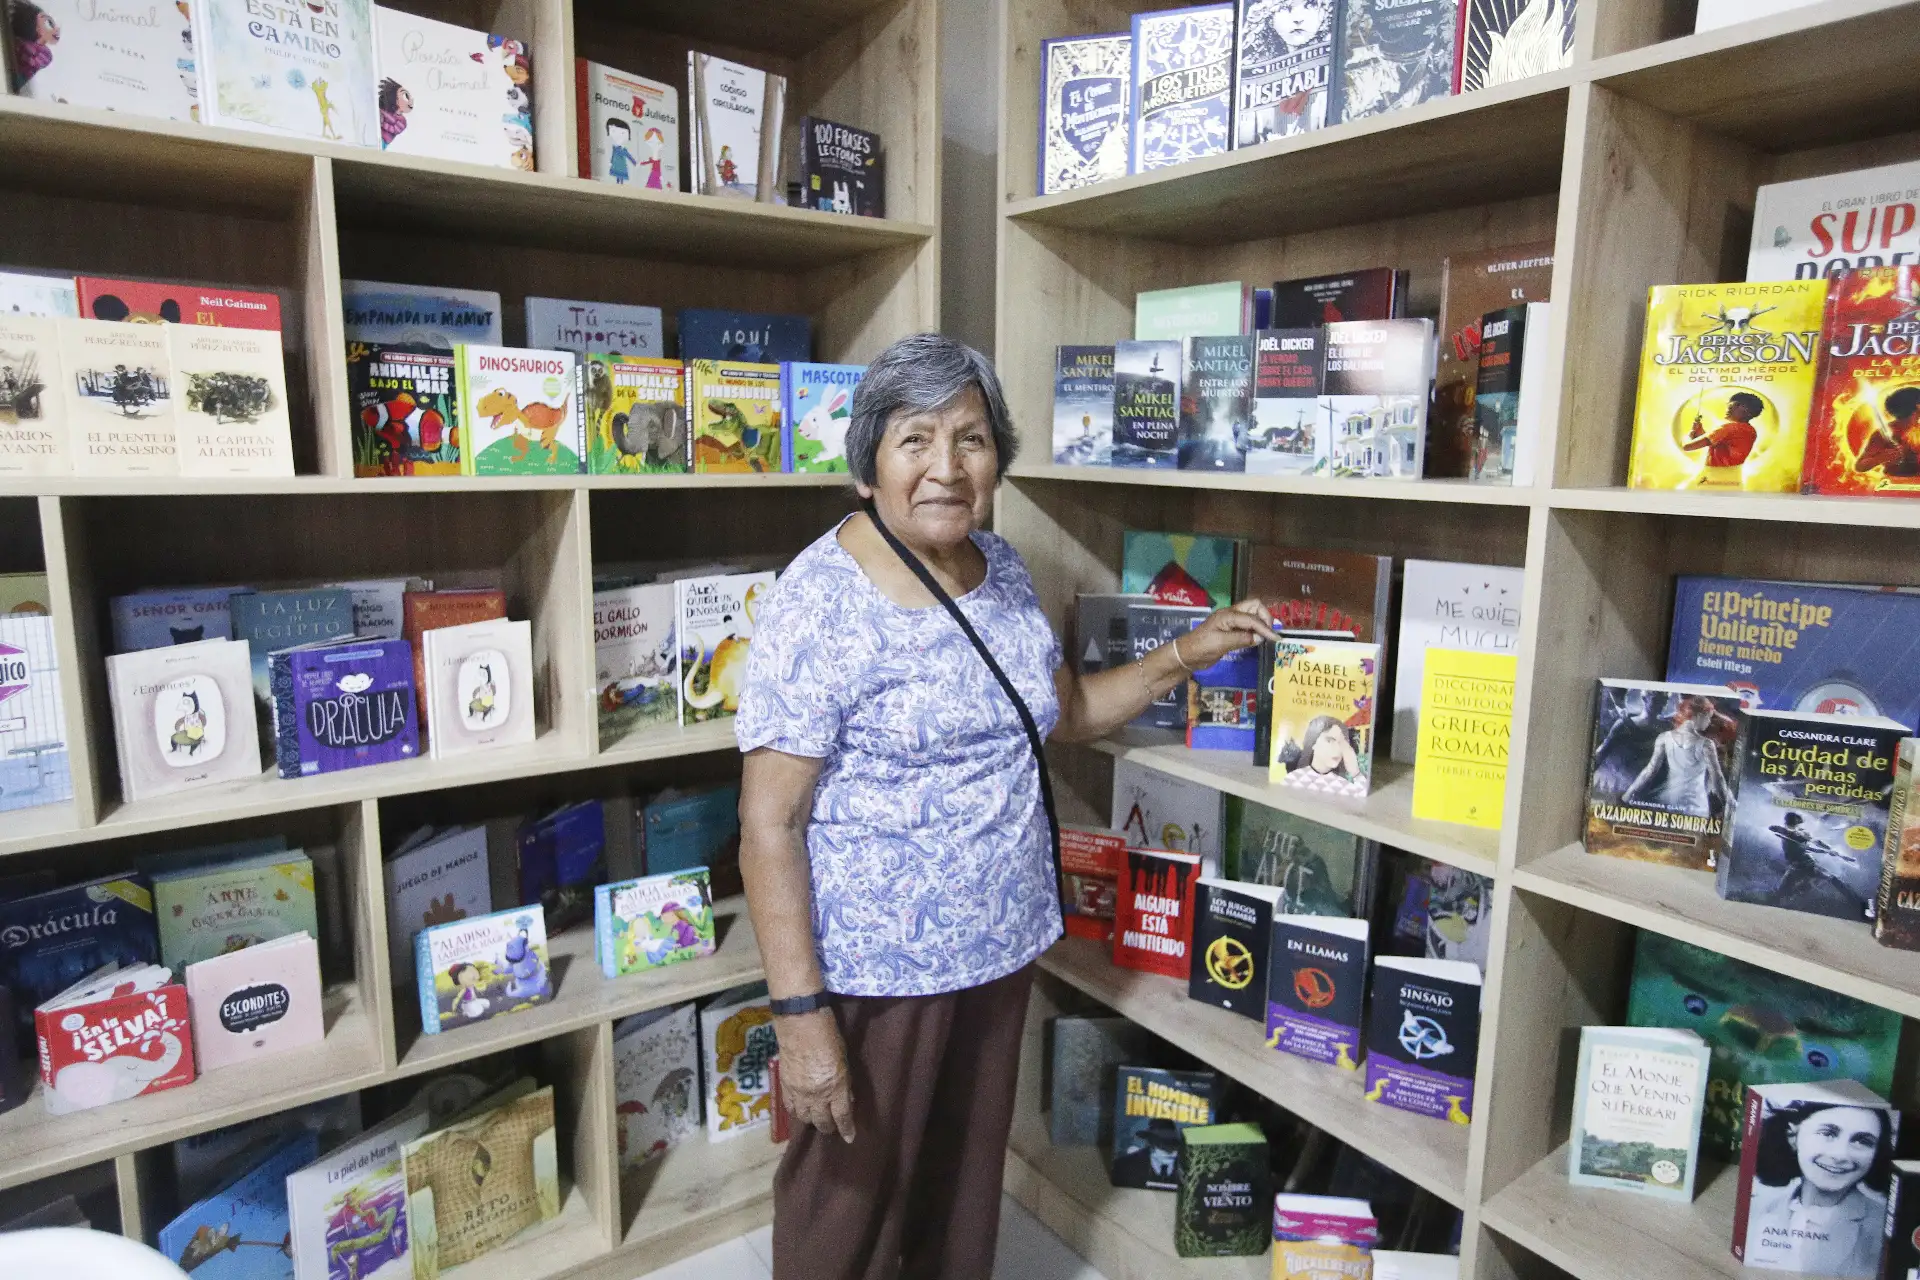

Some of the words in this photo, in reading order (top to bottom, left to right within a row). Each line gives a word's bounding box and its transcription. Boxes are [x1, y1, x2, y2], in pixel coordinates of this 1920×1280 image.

[311, 17, 339, 38] EN
[248, 21, 341, 59] CAMINO
[1151, 72, 1183, 97] LOS
[1185, 61, 1227, 87] TRES
[720, 83, 747, 98] CÓDIGO
[1143, 76, 1229, 112] MOSQUETEROS
[595, 92, 631, 112] Romeo
[645, 107, 676, 125] Julieta
[815, 123, 833, 144] 100
[834, 127, 871, 154] FRASES
[1822, 201, 1832, 211] EL
[1836, 196, 1865, 210] GRAN
[1870, 190, 1902, 205] LIBRO
[1905, 188, 1919, 199] DE
[1488, 262, 1517, 273] OLIVER
[1511, 288, 1524, 299] EL
[1678, 289, 1717, 298] RICK
[1726, 284, 1810, 296] RIORDAN
[200, 296, 223, 307] Neil
[225, 299, 267, 311] Gaiman
[197, 311, 215, 325] El
[345, 308, 420, 325] EMPANADA
[441, 310, 493, 326] MAMUT
[569, 306, 598, 327] Tú
[722, 324, 771, 346] AQUÍ
[1259, 337, 1279, 351] JOËL
[1281, 338, 1315, 351] DICKER
[1328, 330, 1350, 345] JOËL
[1700, 334, 1772, 347] PERCY
[1204, 346, 1246, 357] MIKEL
[1328, 348, 1337, 358] EL
[1654, 331, 1821, 366] JACKSON
[479, 356, 564, 375] DINOSAURIOS
[1076, 355, 1113, 366] MIKEL
[1328, 360, 1342, 371] LOS
[1871, 358, 1893, 368] LA
[370, 362, 449, 380] ANIMALES
[1063, 367, 1114, 378] SANTIAG
[1669, 367, 1684, 375] EL
[1690, 366, 1742, 375] ÚLTIMO
[1747, 365, 1799, 374] HÉROE
[1720, 374, 1775, 383] OLIMPO
[1853, 369, 1885, 378] DEL
[370, 378, 399, 388] BAJO
[402, 380, 414, 390] EL
[416, 380, 449, 394] MAR
[614, 374, 679, 389] ANIMALES
[1064, 384, 1073, 392] EL
[1077, 384, 1115, 392] MENTIRO
[1200, 379, 1228, 388] ENTRE
[1231, 379, 1249, 388] LOS
[628, 390, 636, 398] LA
[638, 388, 675, 401] SELVA
[1135, 394, 1172, 405] MIKEL
[1201, 389, 1245, 398] MUERTOS
[1120, 407, 1175, 418] SANTIAG
[1133, 421, 1144, 430] EN
[1147, 422, 1174, 430] PLENA
[88, 433, 102, 442] EL
[109, 433, 161, 443] PUENTE
[197, 436, 210, 444] EL
[217, 435, 275, 445] CAPITÁN
[1137, 432, 1169, 440] NOCHE
[90, 445, 116, 455] LOS
[120, 445, 176, 455] ASESINO
[200, 447, 276, 457] ALATRISTE
[194, 602, 232, 614] GATO
[261, 602, 286, 615] LA
[296, 598, 337, 613] LUZ
[594, 609, 604, 625] EL
[608, 606, 641, 623] GALLO
[1435, 597, 1464, 619] ME
[1471, 601, 1520, 627] QUIE
[1703, 591, 1720, 612] El
[1722, 587, 1832, 630] Príncipe
[254, 621, 341, 640] EGIPTO
[594, 621, 648, 643] DORMILÓN
[1701, 613, 1798, 649] Valiente
[1699, 638, 1734, 657] tiene
[1737, 645, 1782, 665] miedo
[1297, 660, 1348, 677] ISABEL
[1289, 673, 1356, 692] ALLENDE
[1292, 698, 1308, 706] LOS
[1311, 699, 1351, 711] ESPÍRITUS
[1310, 691, 1332, 700] CASA
[1336, 693, 1346, 701] DE
[1433, 693, 1449, 705] DE
[1431, 714, 1512, 738] GRIEGA
[1431, 735, 1509, 759] ROMAN
[1779, 729, 1840, 743] CASSANDRA
[1842, 736, 1877, 747] CLARE
[1762, 740, 1849, 767] Ciudad
[1856, 750, 1889, 772] de
[1760, 758, 1788, 777] las
[1792, 763, 1857, 784] Almas
[1805, 782, 1883, 801] perdidas
[1629, 799, 1666, 809] CASSANDRA
[1593, 802, 1653, 826] CAZADORES
[1654, 811, 1668, 828] DE
[1669, 813, 1722, 835] SOMBRAS
[396, 872, 429, 894] JUEGO
[445, 850, 479, 871] MANOS
[1134, 893, 1180, 917] ALGUIEN
[1209, 904, 1225, 915] DEL
[1226, 908, 1257, 924] HAMBRE
[1211, 897, 1228, 907] LOS
[1229, 900, 1257, 916] JUEGOS
[2, 904, 118, 948] Drácula
[1141, 914, 1168, 935] ESTÁ
[440, 927, 492, 952] ALADINO
[1123, 930, 1186, 958] MINTIENDO
[1287, 938, 1303, 952] EN
[1305, 941, 1349, 963] LLAMAS
[223, 990, 287, 1018] ESCONDITES
[1399, 986, 1454, 1009] SINSAJO
[72, 1025, 103, 1051] ¡En
[103, 1017, 120, 1031] la
[83, 1002, 168, 1062] SELVA!
[1602, 1062, 1617, 1078] EL
[1625, 1064, 1683, 1088] MONJE
[1127, 1075, 1143, 1094] EL
[1148, 1080, 1210, 1109] HOMBRE
[1591, 1080, 1623, 1096] QUE
[1630, 1083, 1691, 1106] VENDIÓ
[1125, 1092, 1210, 1125] INVISIBLE
[1620, 1099, 1677, 1121] FERRARI
[1749, 1097, 1759, 1127] FRANK
[327, 1171, 340, 1184] La
[341, 1159, 357, 1179] piel
[358, 1155, 369, 1168] de
[1206, 1182, 1251, 1193] NOMBRE
[1203, 1195, 1253, 1208] VIENTO
[1762, 1226, 1789, 1238] ANA
[1790, 1228, 1831, 1242] FRANK
[1761, 1238, 1792, 1250] Diario
